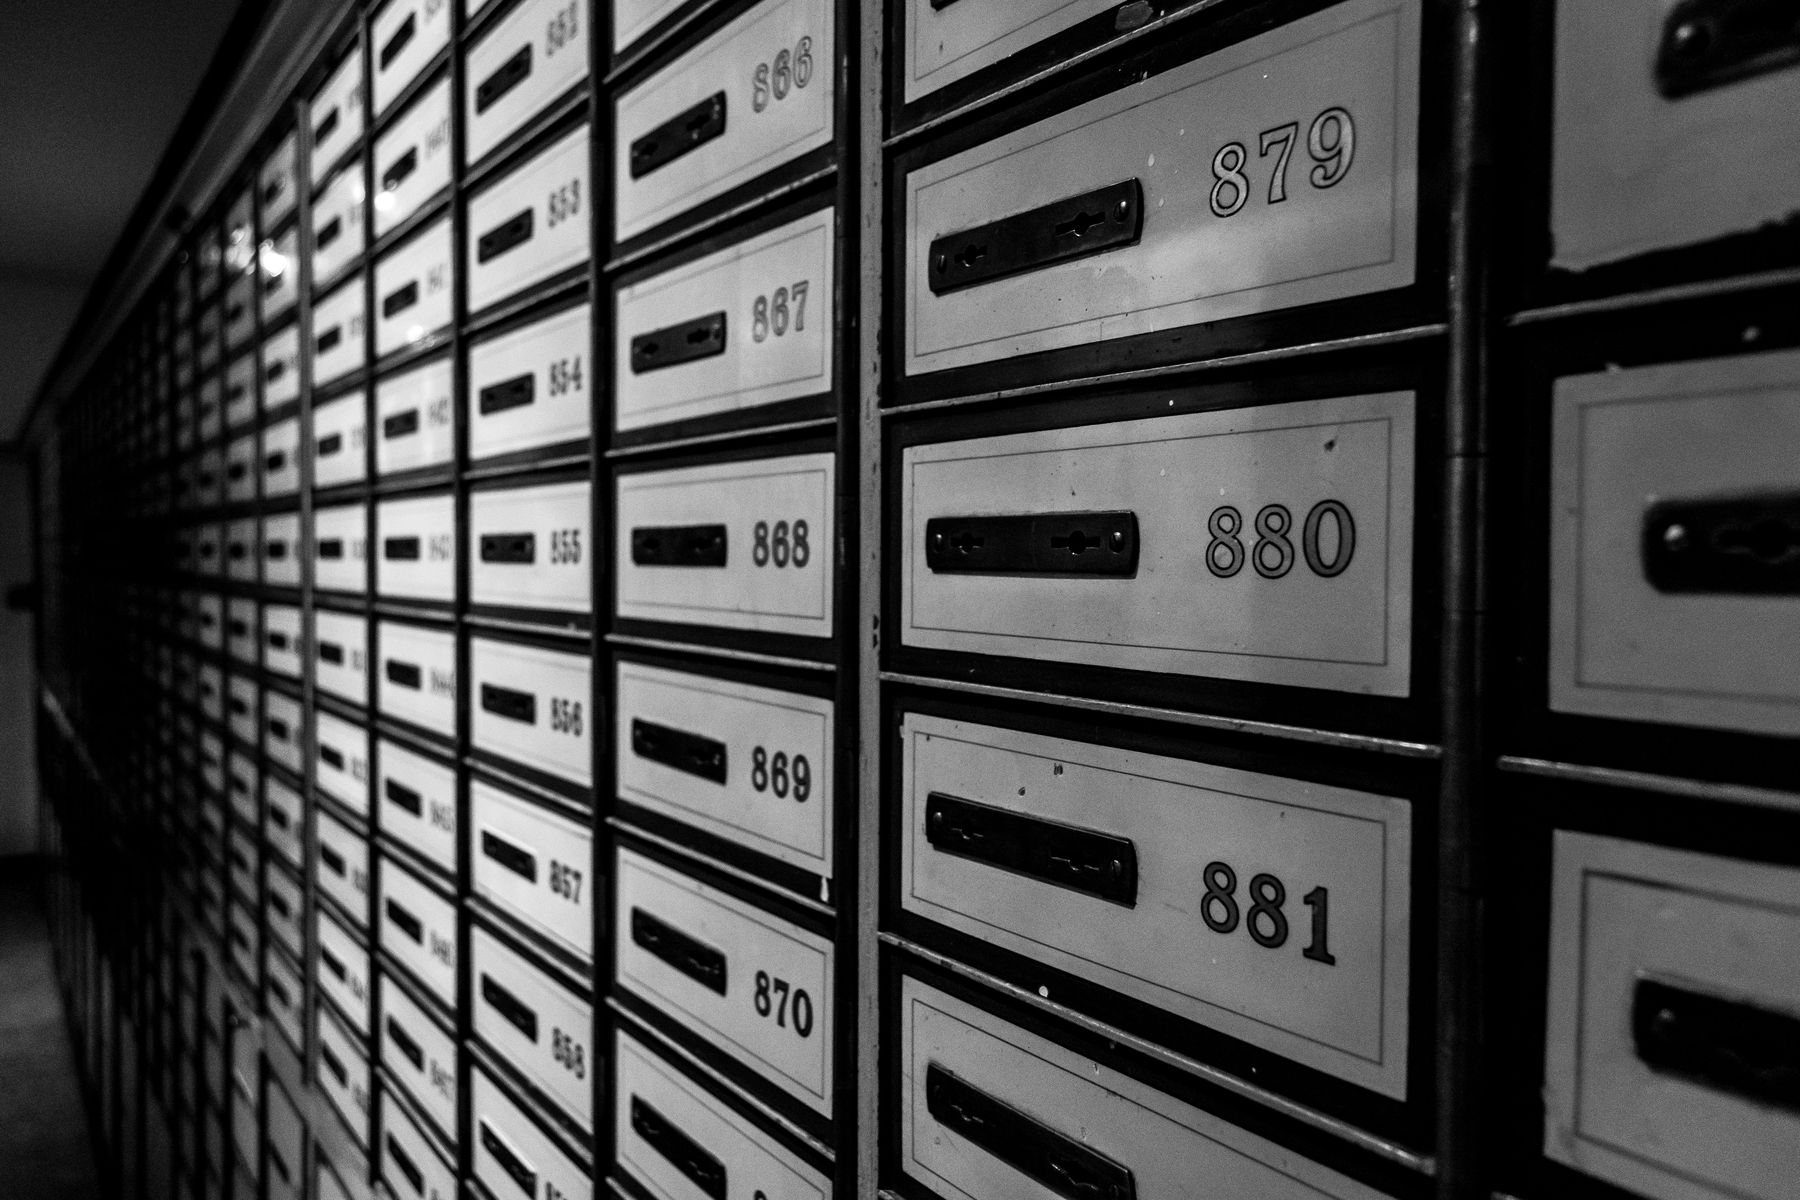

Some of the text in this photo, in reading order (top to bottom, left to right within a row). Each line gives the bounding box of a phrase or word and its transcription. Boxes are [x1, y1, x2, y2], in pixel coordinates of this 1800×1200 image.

[752, 36, 813, 113] 866
[1210, 106, 1357, 217] 879
[752, 280, 810, 343] 867
[549, 355, 582, 397] 854
[752, 519, 810, 569] 868
[1206, 499, 1357, 578] 880
[551, 696, 583, 737] 856
[751, 745, 811, 803] 869
[549, 859, 582, 904] 857
[1201, 860, 1337, 965] 881
[754, 970, 813, 1038] 870
[552, 1027, 585, 1080] 858
